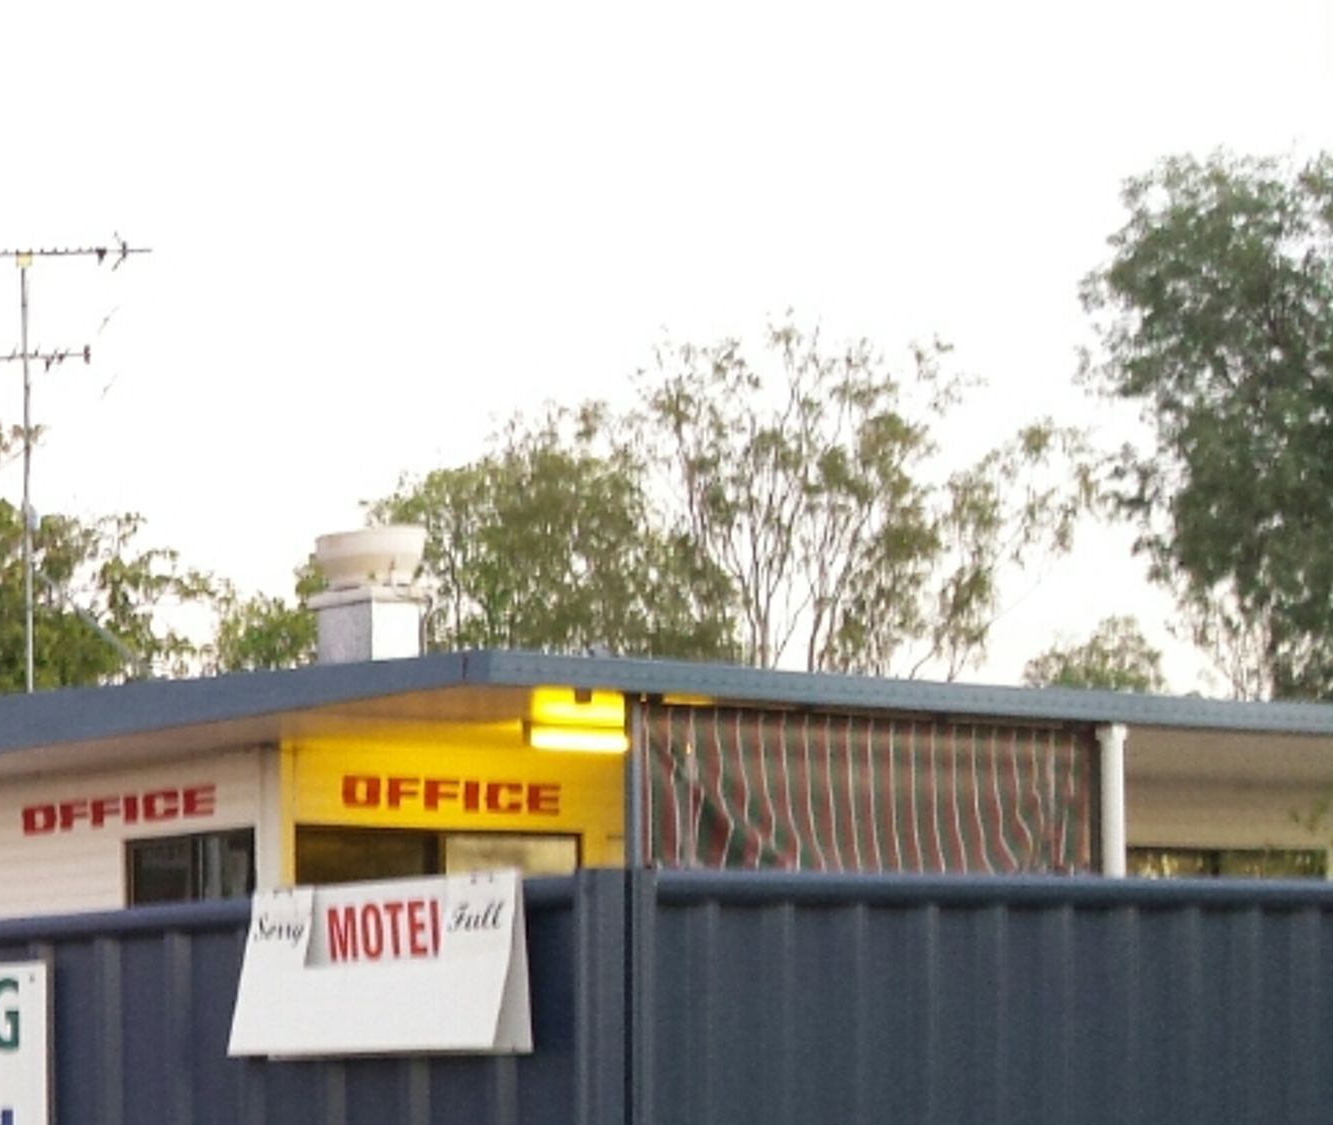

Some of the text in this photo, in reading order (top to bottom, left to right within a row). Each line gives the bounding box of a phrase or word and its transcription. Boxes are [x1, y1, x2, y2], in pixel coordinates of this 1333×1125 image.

[22, 783, 216, 836] OFFICE
[342, 774, 562, 816] OFFICE
[253, 914, 305, 948] Sorry
[446, 901, 505, 933] Full
